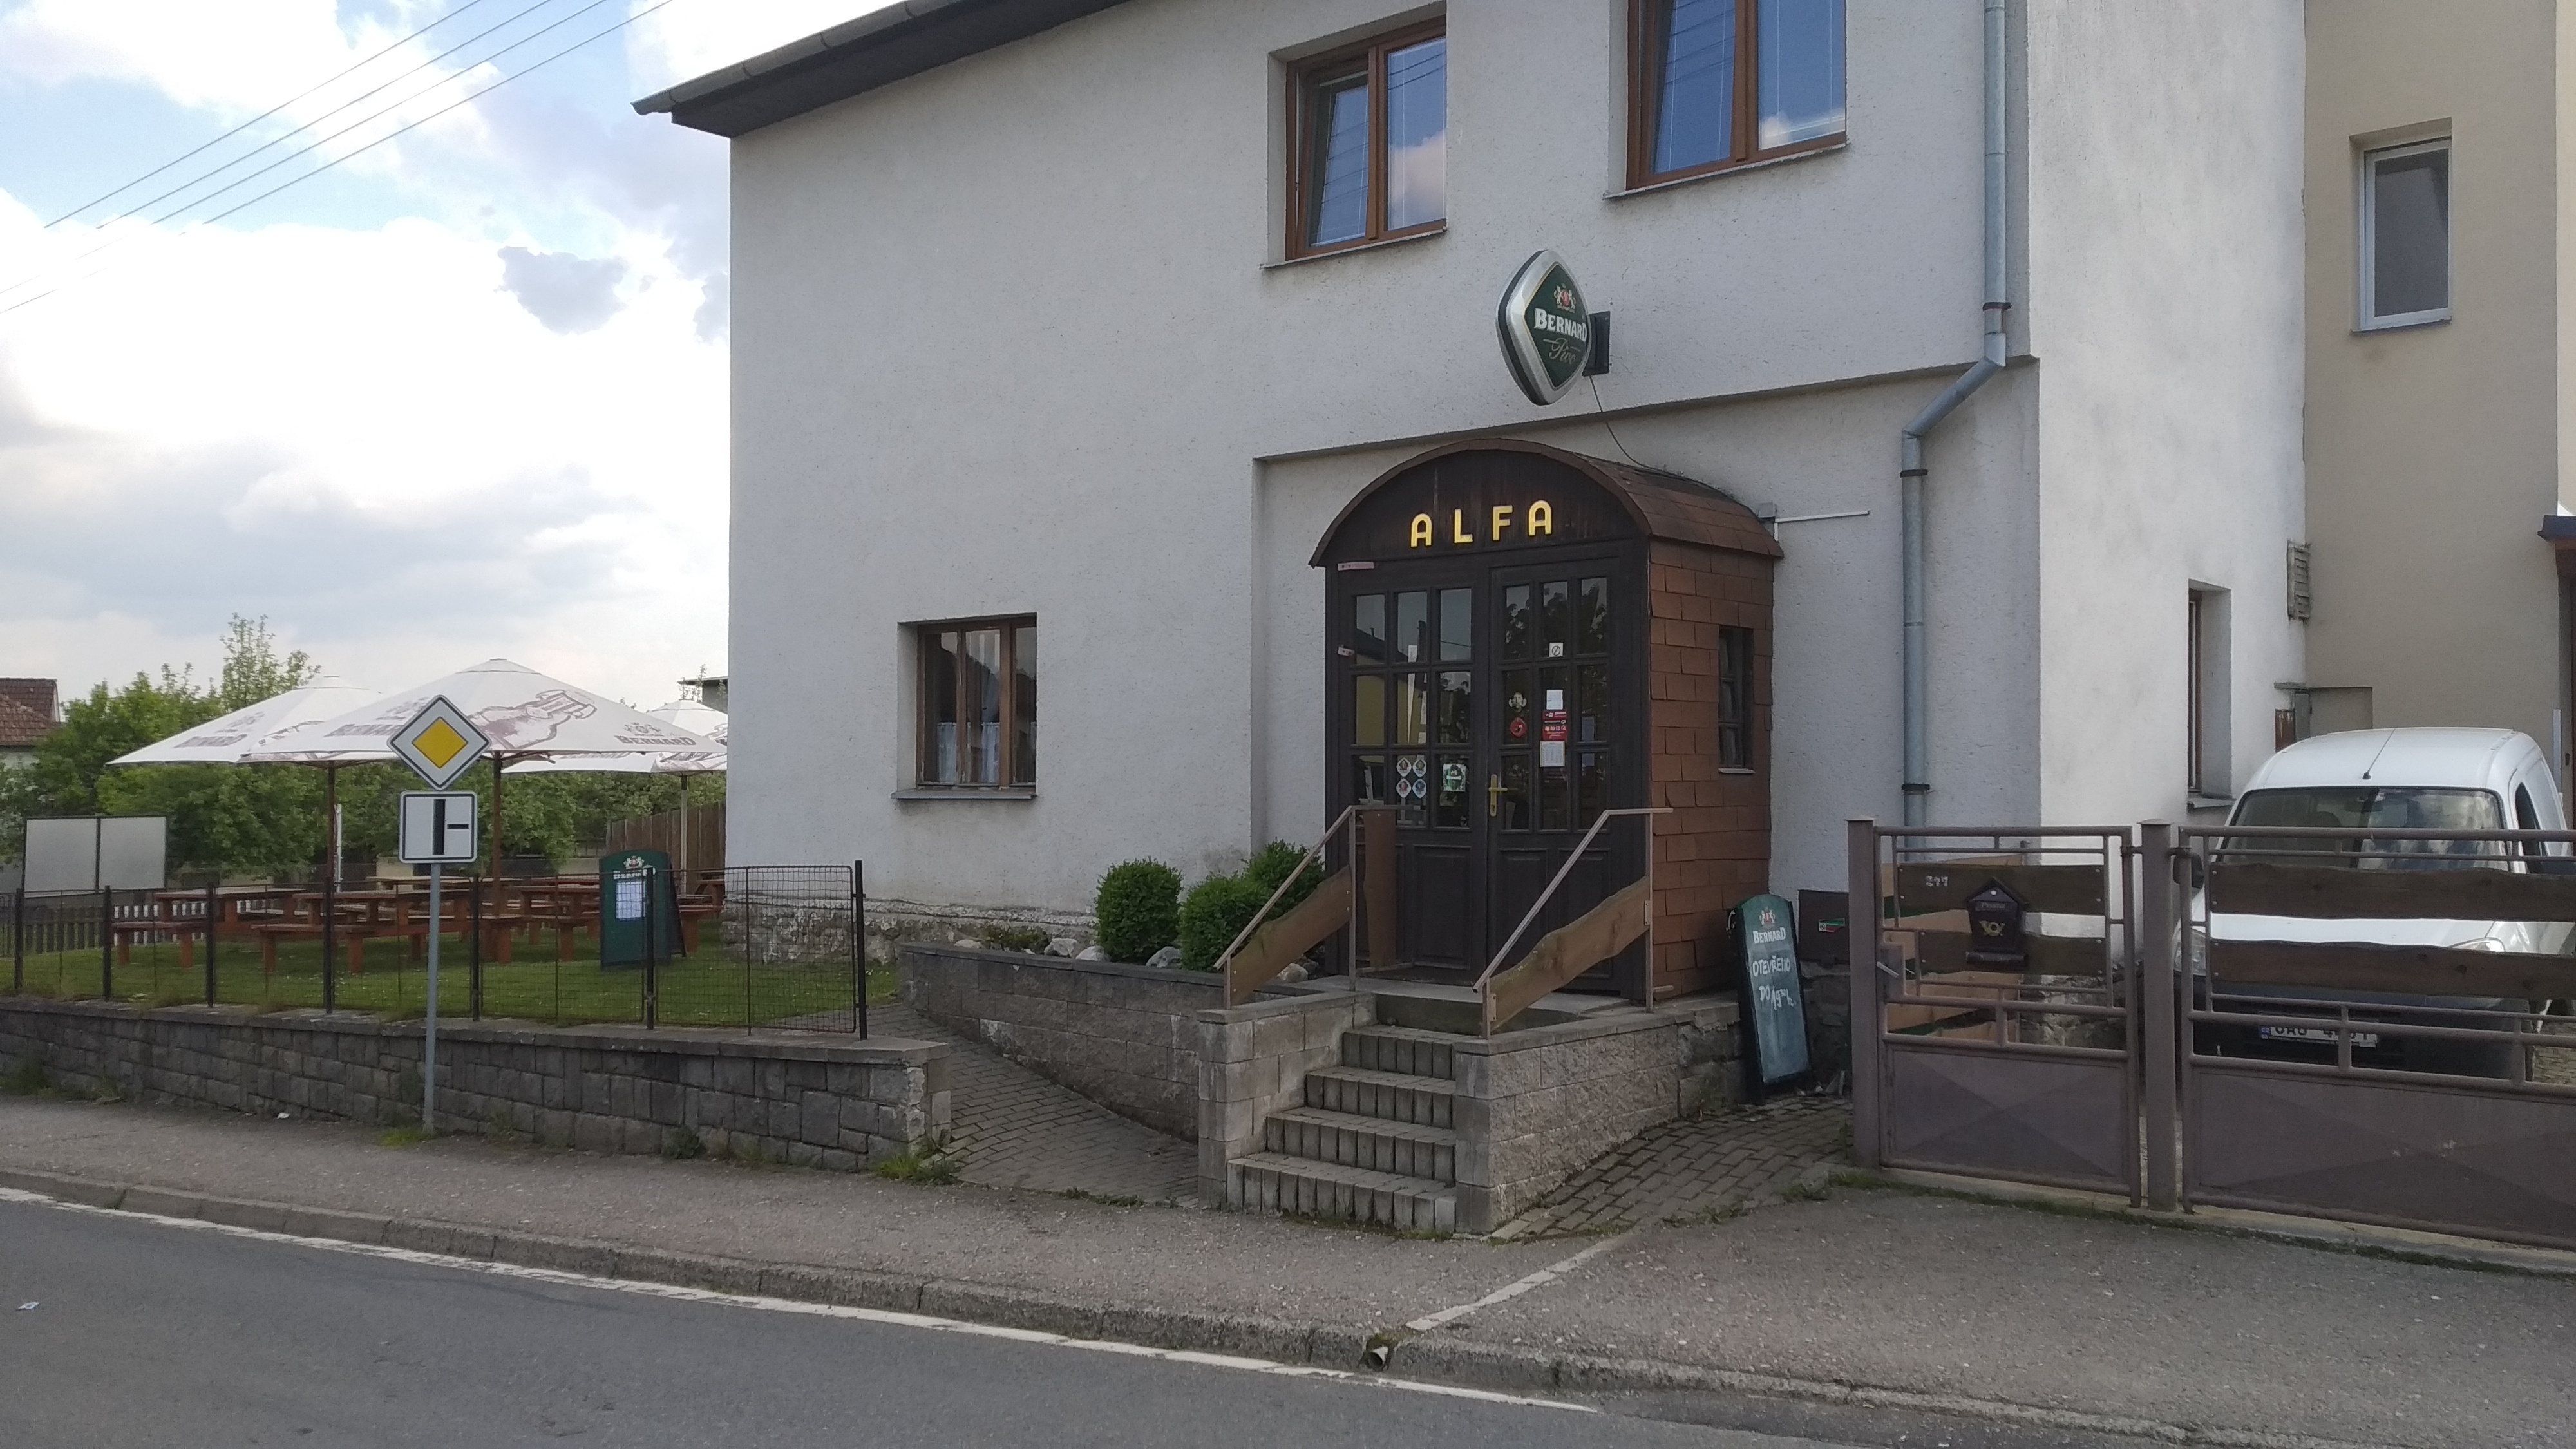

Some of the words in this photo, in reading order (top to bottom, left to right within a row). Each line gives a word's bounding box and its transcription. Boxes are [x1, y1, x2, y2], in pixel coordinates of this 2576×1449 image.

[1534, 308, 1587, 343] BERNARD
[1410, 500, 1552, 547] ALFA
[614, 735, 697, 746] BERNARD
[1752, 927, 1786, 943] BERNARD
